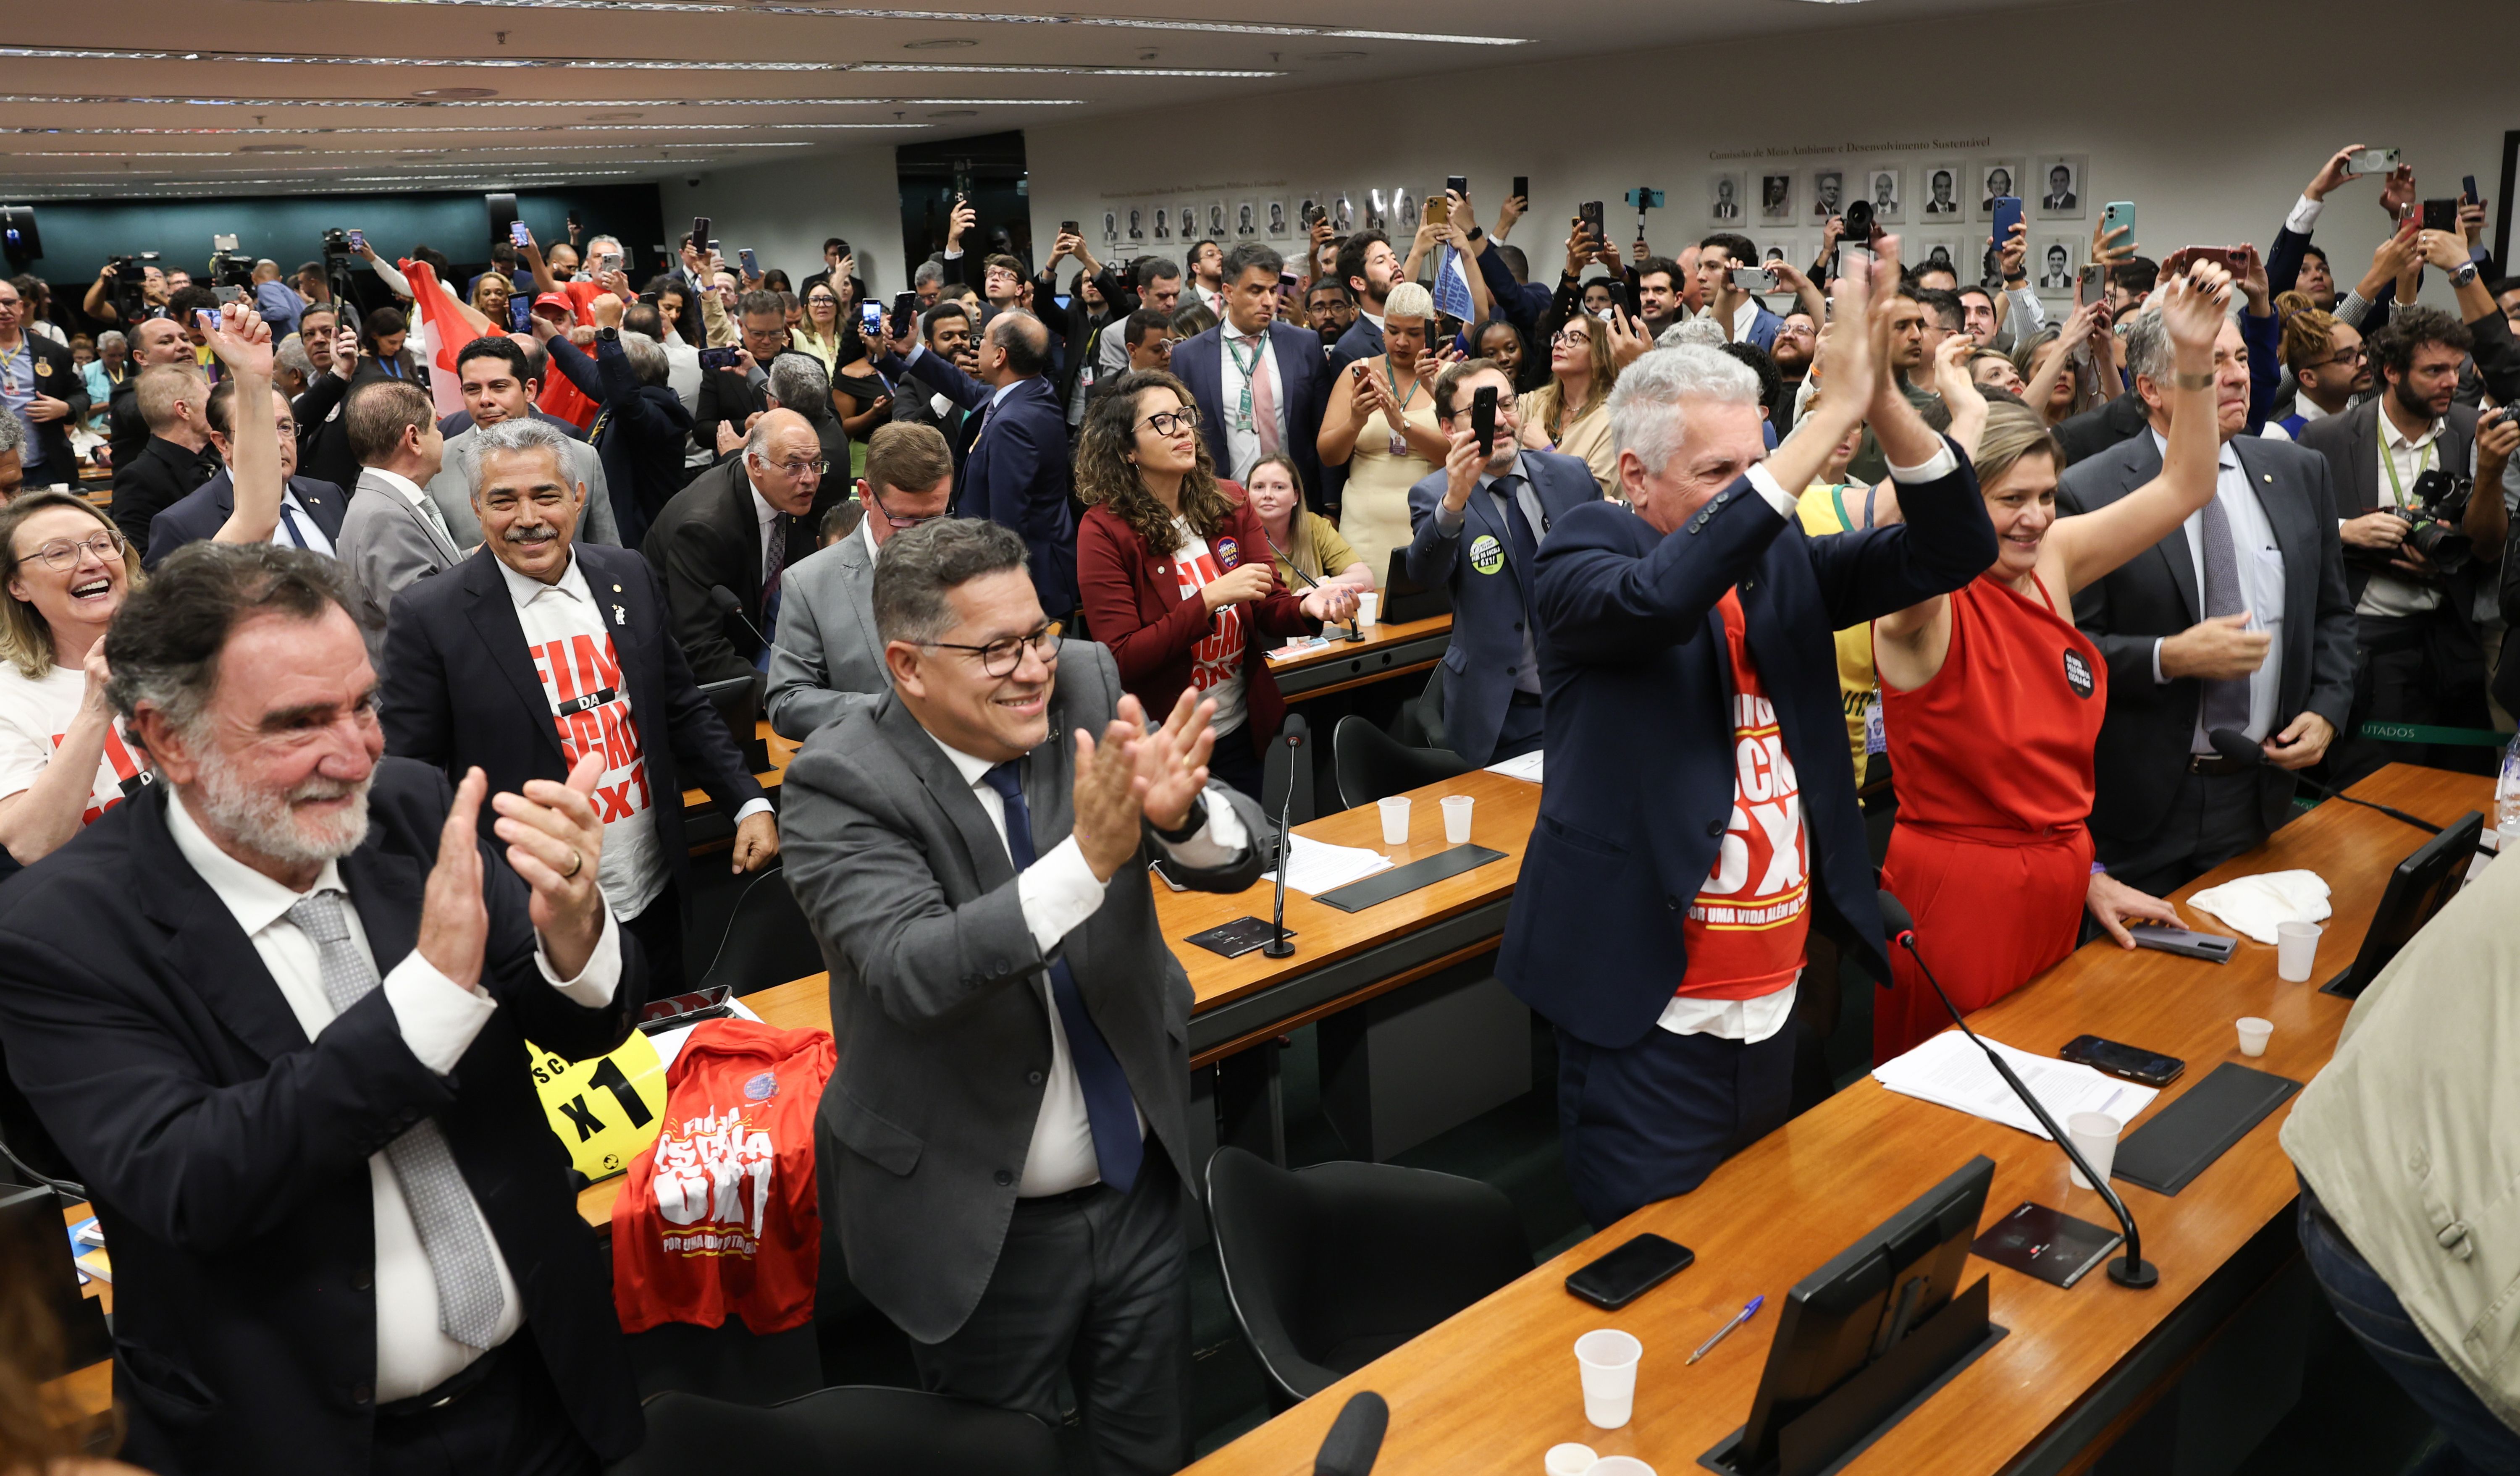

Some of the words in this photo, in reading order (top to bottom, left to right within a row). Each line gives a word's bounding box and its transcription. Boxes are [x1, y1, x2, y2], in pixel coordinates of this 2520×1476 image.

[1709, 150, 1751, 160] Comissão
[1753, 148, 1764, 157] de
[1767, 147, 1789, 157] Meio
[1791, 144, 1834, 155] Ambiente
[1846, 141, 1929, 152] Desenvolvimento
[1932, 136, 1990, 149] Sustentável
[1446, 276, 1461, 311] VIVER
[1218, 542, 1235, 554] TEMPO
[1221, 547, 1237, 559] VIVER
[1471, 554, 1480, 562] FIM
[1480, 551, 1486, 559] DA
[1480, 555, 1495, 567] 6X1!
[578, 694, 600, 710] DA
[1707, 908, 1734, 923] UMA
[1737, 908, 1764, 924] VIDA
[1767, 903, 1788, 923] ALÉM
[663, 1237, 681, 1253] POR
[683, 1234, 704, 1251] UMA
